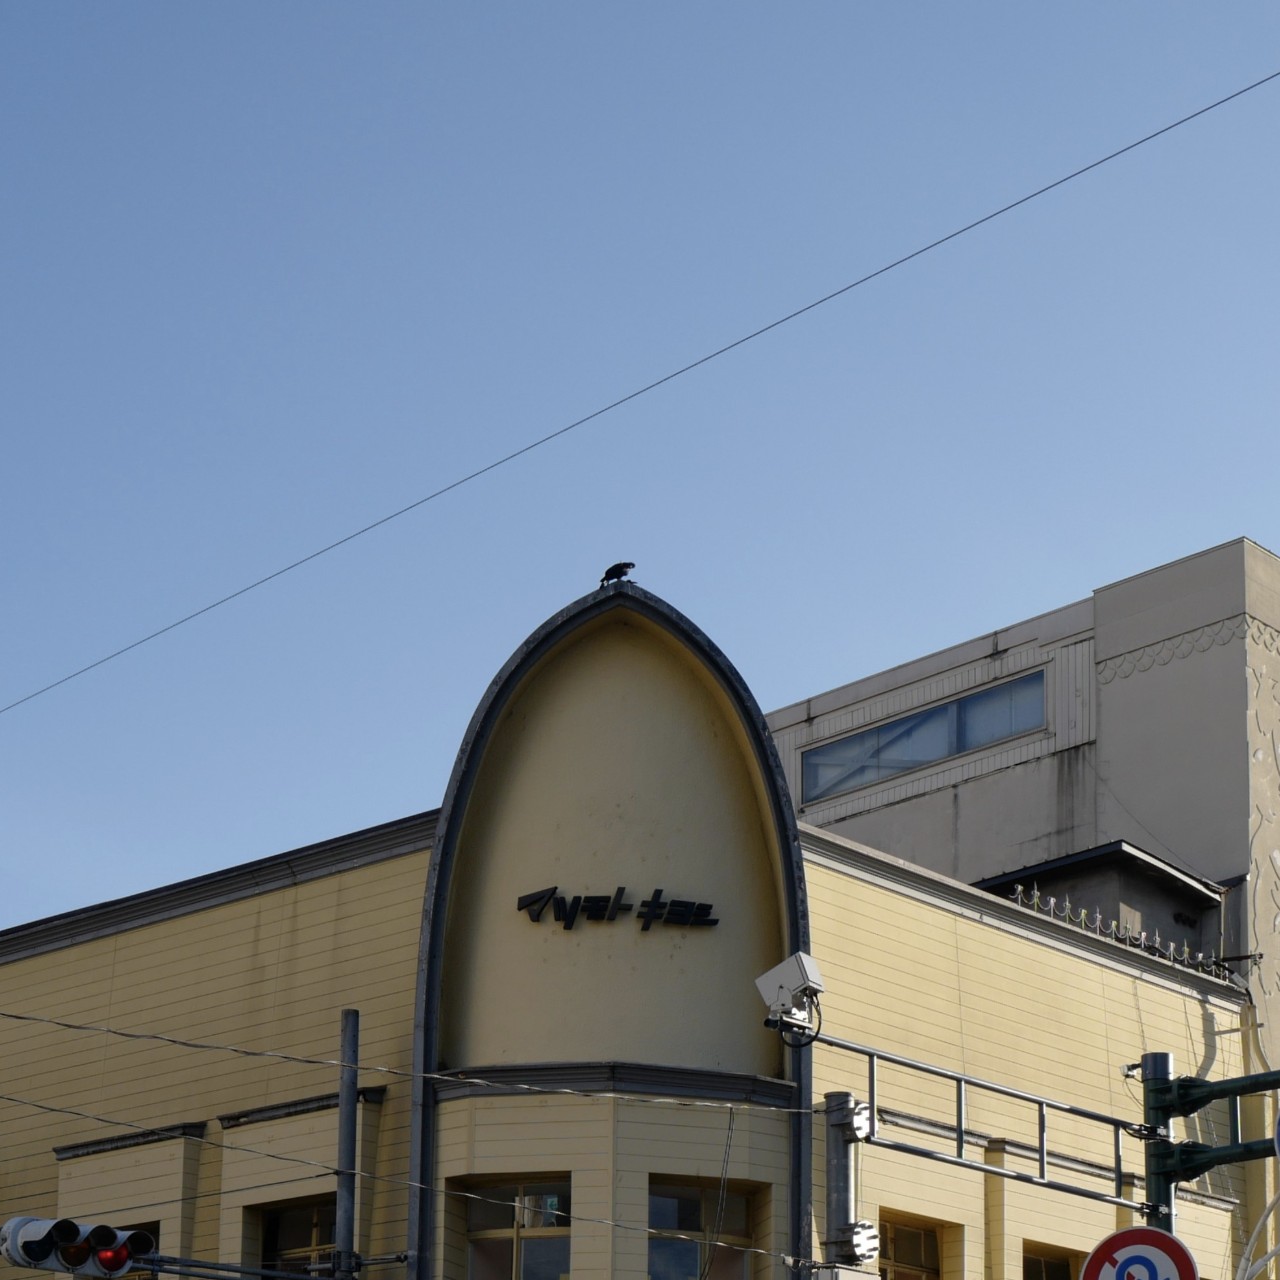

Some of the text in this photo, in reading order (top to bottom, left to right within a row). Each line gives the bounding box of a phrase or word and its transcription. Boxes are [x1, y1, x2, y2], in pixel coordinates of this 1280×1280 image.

[517, 886, 720, 931] マツモトキヨシ
